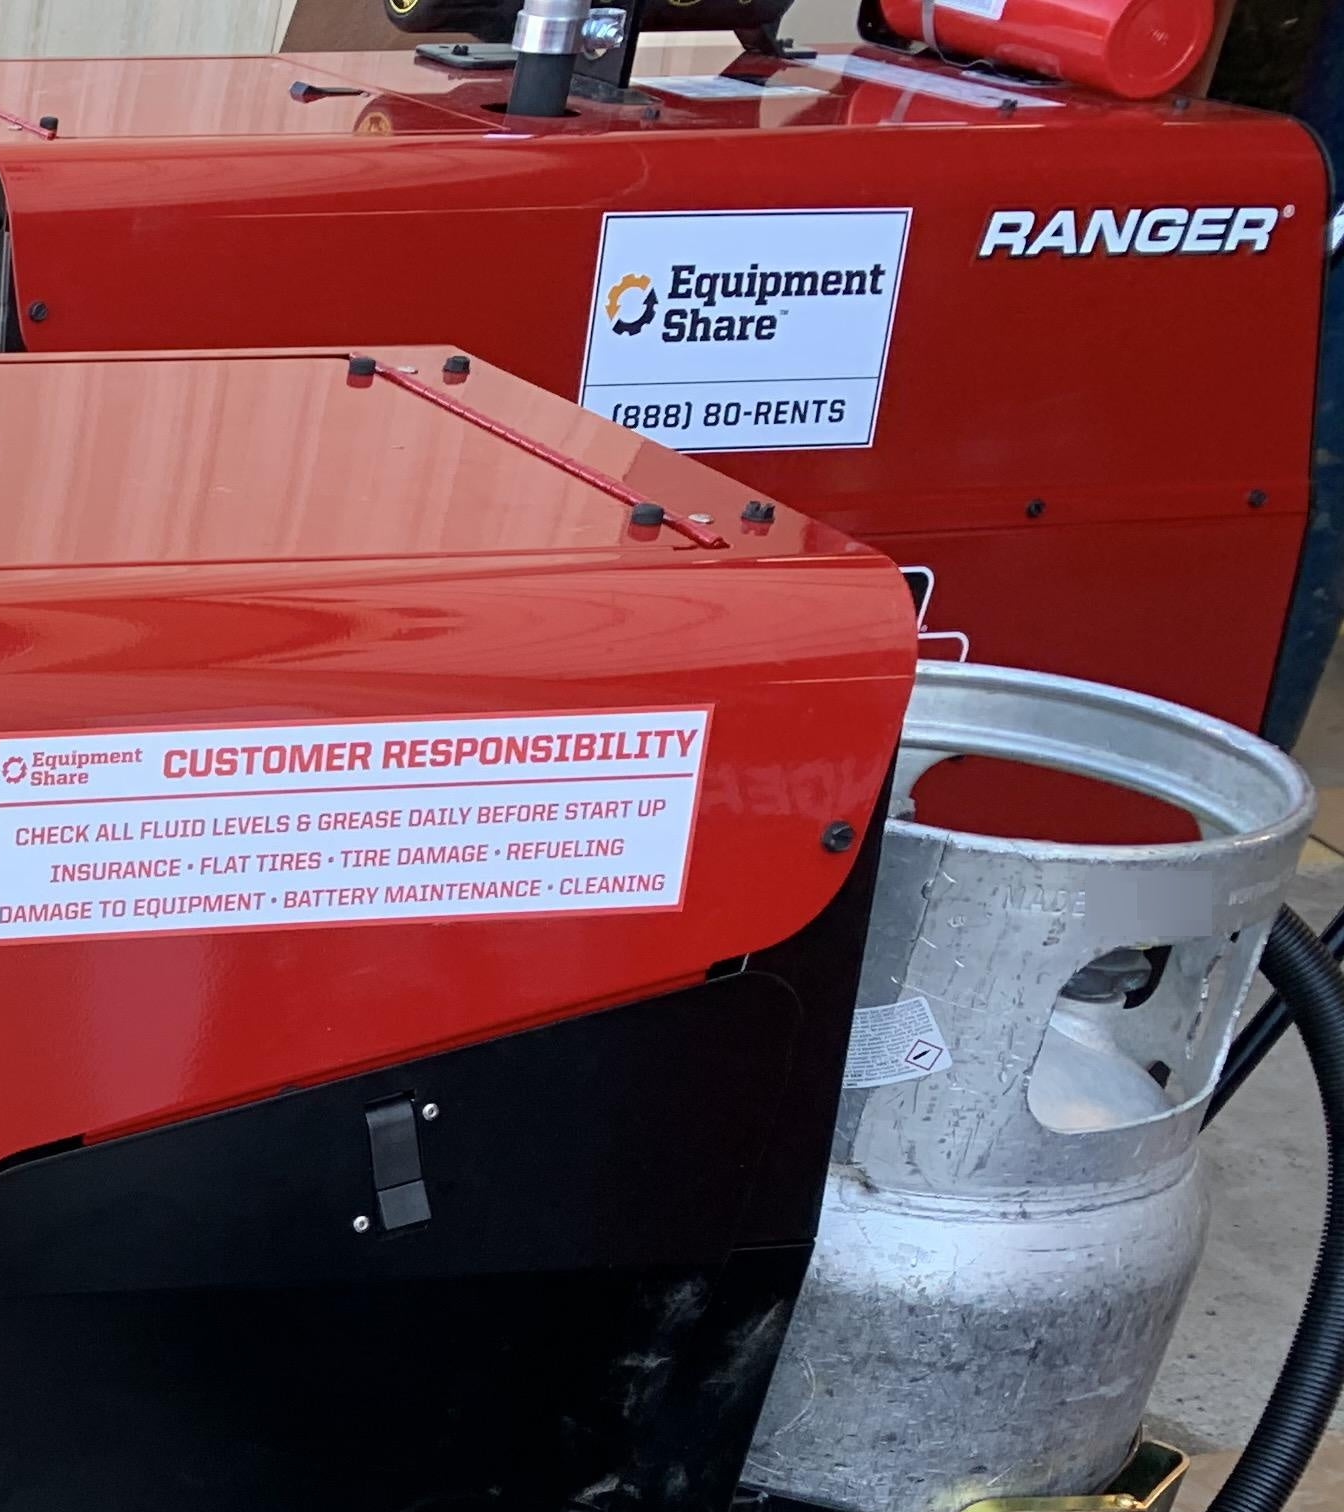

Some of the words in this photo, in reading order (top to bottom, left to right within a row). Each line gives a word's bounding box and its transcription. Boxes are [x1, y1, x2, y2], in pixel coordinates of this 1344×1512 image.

[667, 262, 887, 307] Equipment
[611, 401, 695, 432] (888)
[703, 398, 846, 429] 80-RENTS
[31, 747, 143, 769] Equipment
[162, 740, 372, 780] CUSTOMER
[382, 729, 699, 770] RESPONSIBILITY
[30, 768, 89, 787] Share
[15, 824, 91, 846] CHECK
[95, 821, 136, 843] ALL
[141, 817, 206, 841] FLUID
[212, 813, 290, 838] LEVELS
[295, 811, 312, 834] &
[317, 808, 402, 833] GREASE
[408, 806, 473, 829] DAILY
[477, 803, 560, 826] BEFORE
[564, 800, 633, 822] START
[637, 799, 666, 818] UP
[50, 858, 182, 884] INSURANCE
[200, 855, 251, 876] FLAT
[255, 852, 322, 874] TIRES
[340, 849, 393, 870] TIRE
[396, 844, 490, 868] DAMAGE
[506, 838, 625, 863] REFUELING
[97, 898, 127, 919] TO
[133, 892, 266, 920] EQUIPMENT
[283, 886, 379, 910] BATTERY
[384, 878, 542, 905] MAINTENANCE
[559, 873, 666, 897] CLEANING
